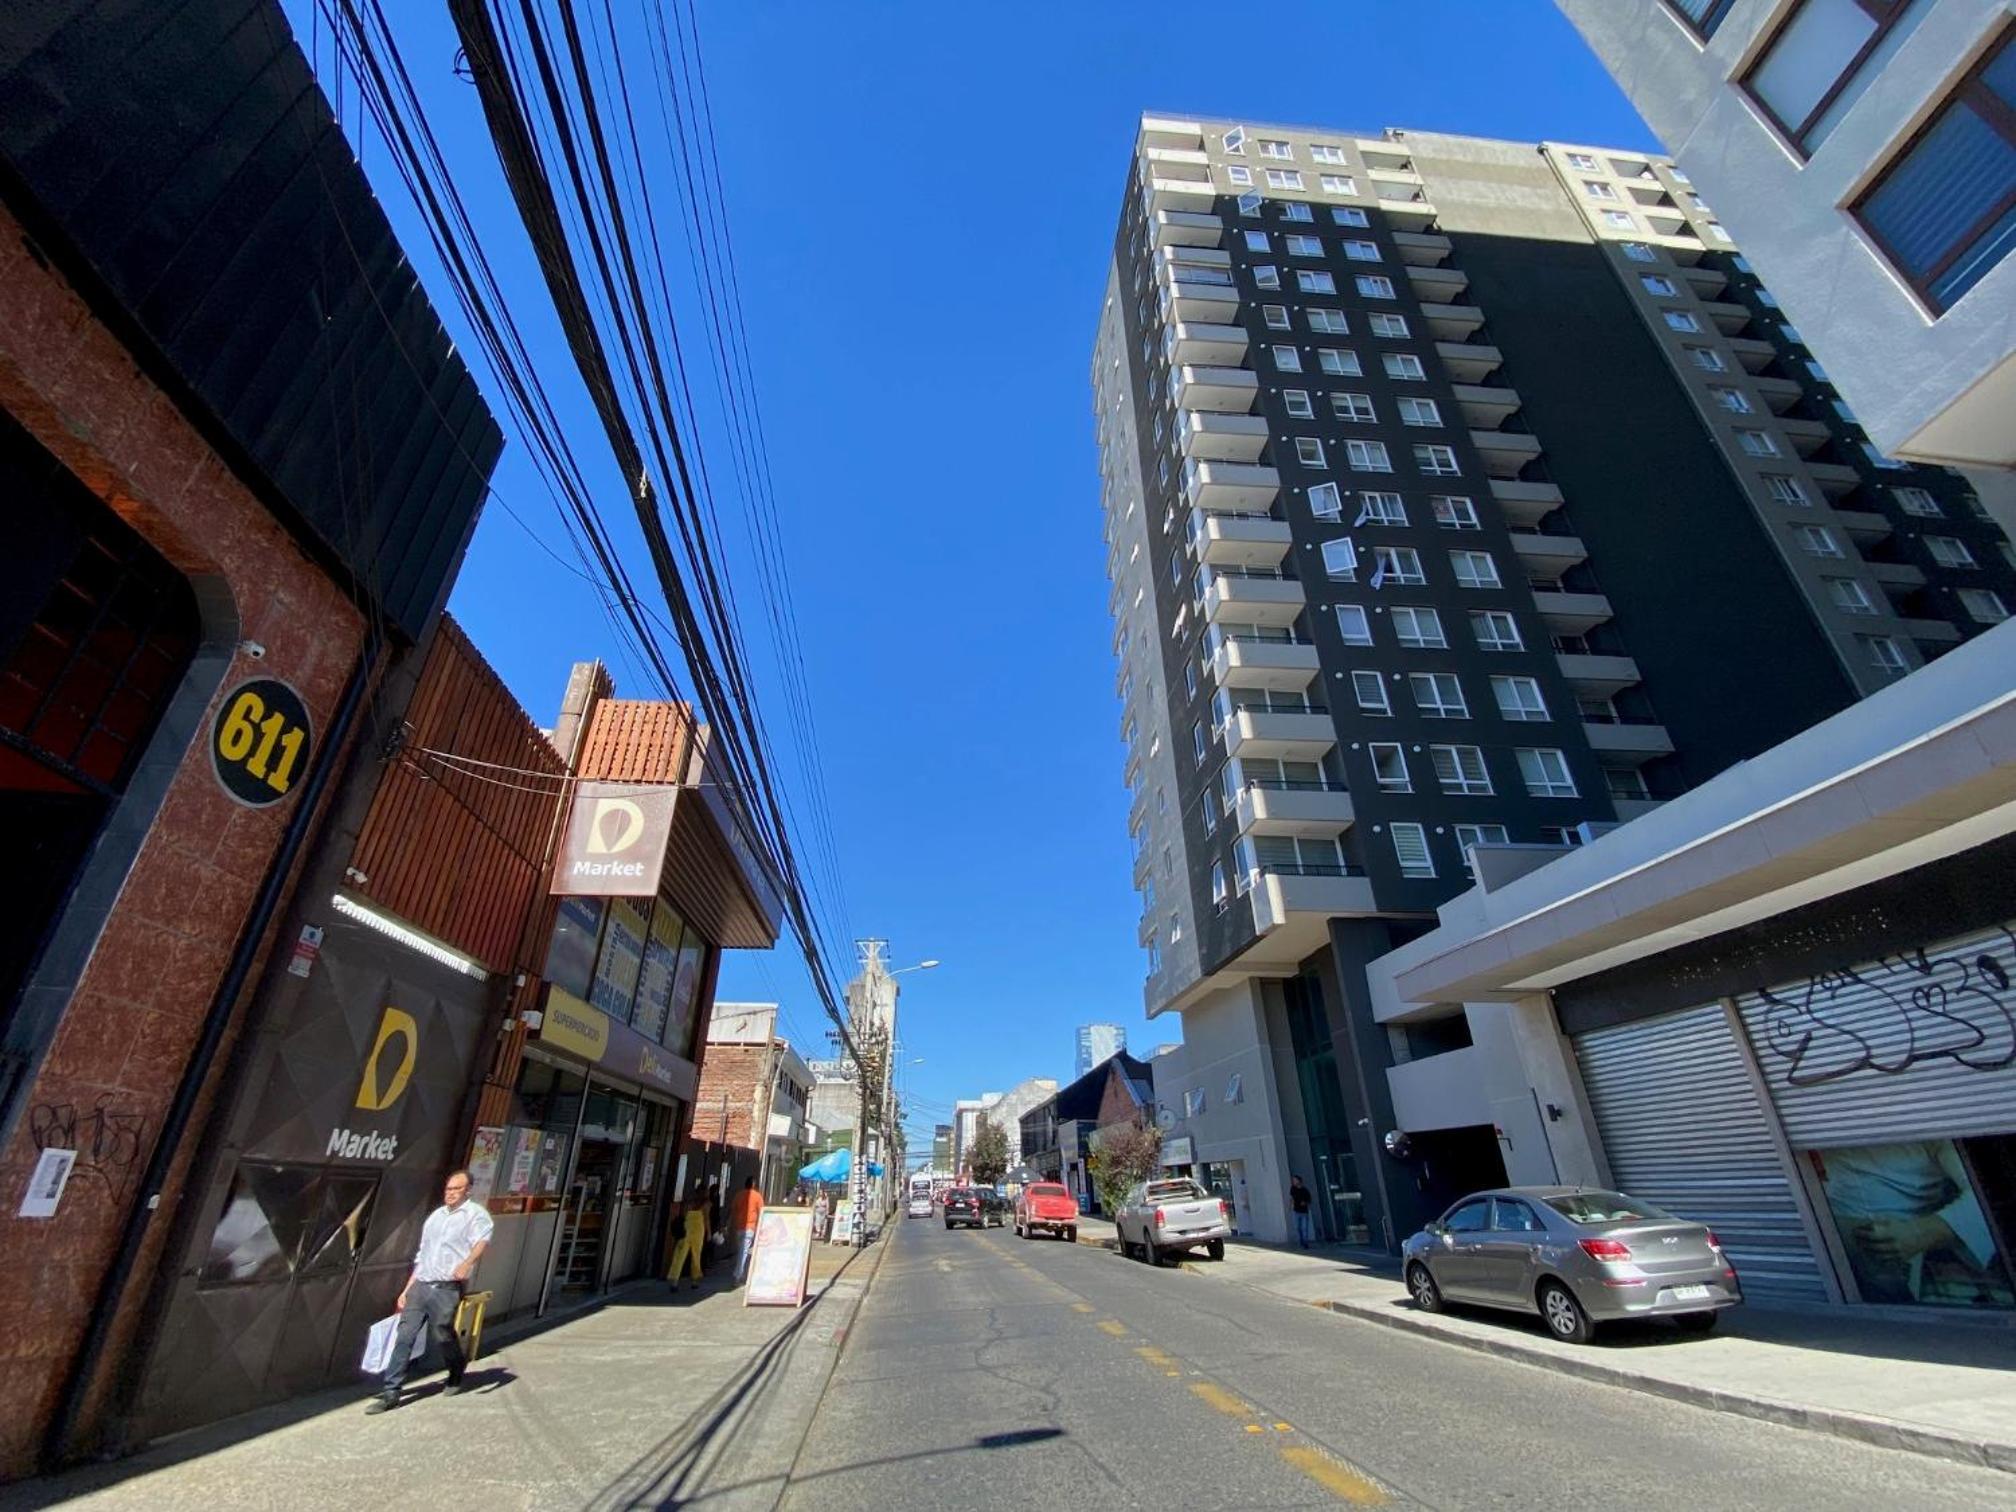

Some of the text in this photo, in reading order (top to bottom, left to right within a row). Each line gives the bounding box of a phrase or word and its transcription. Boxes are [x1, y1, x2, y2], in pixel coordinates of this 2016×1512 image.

[219, 692, 305, 793] 611
[572, 860, 645, 876] Market
[325, 1128, 398, 1160] Market
